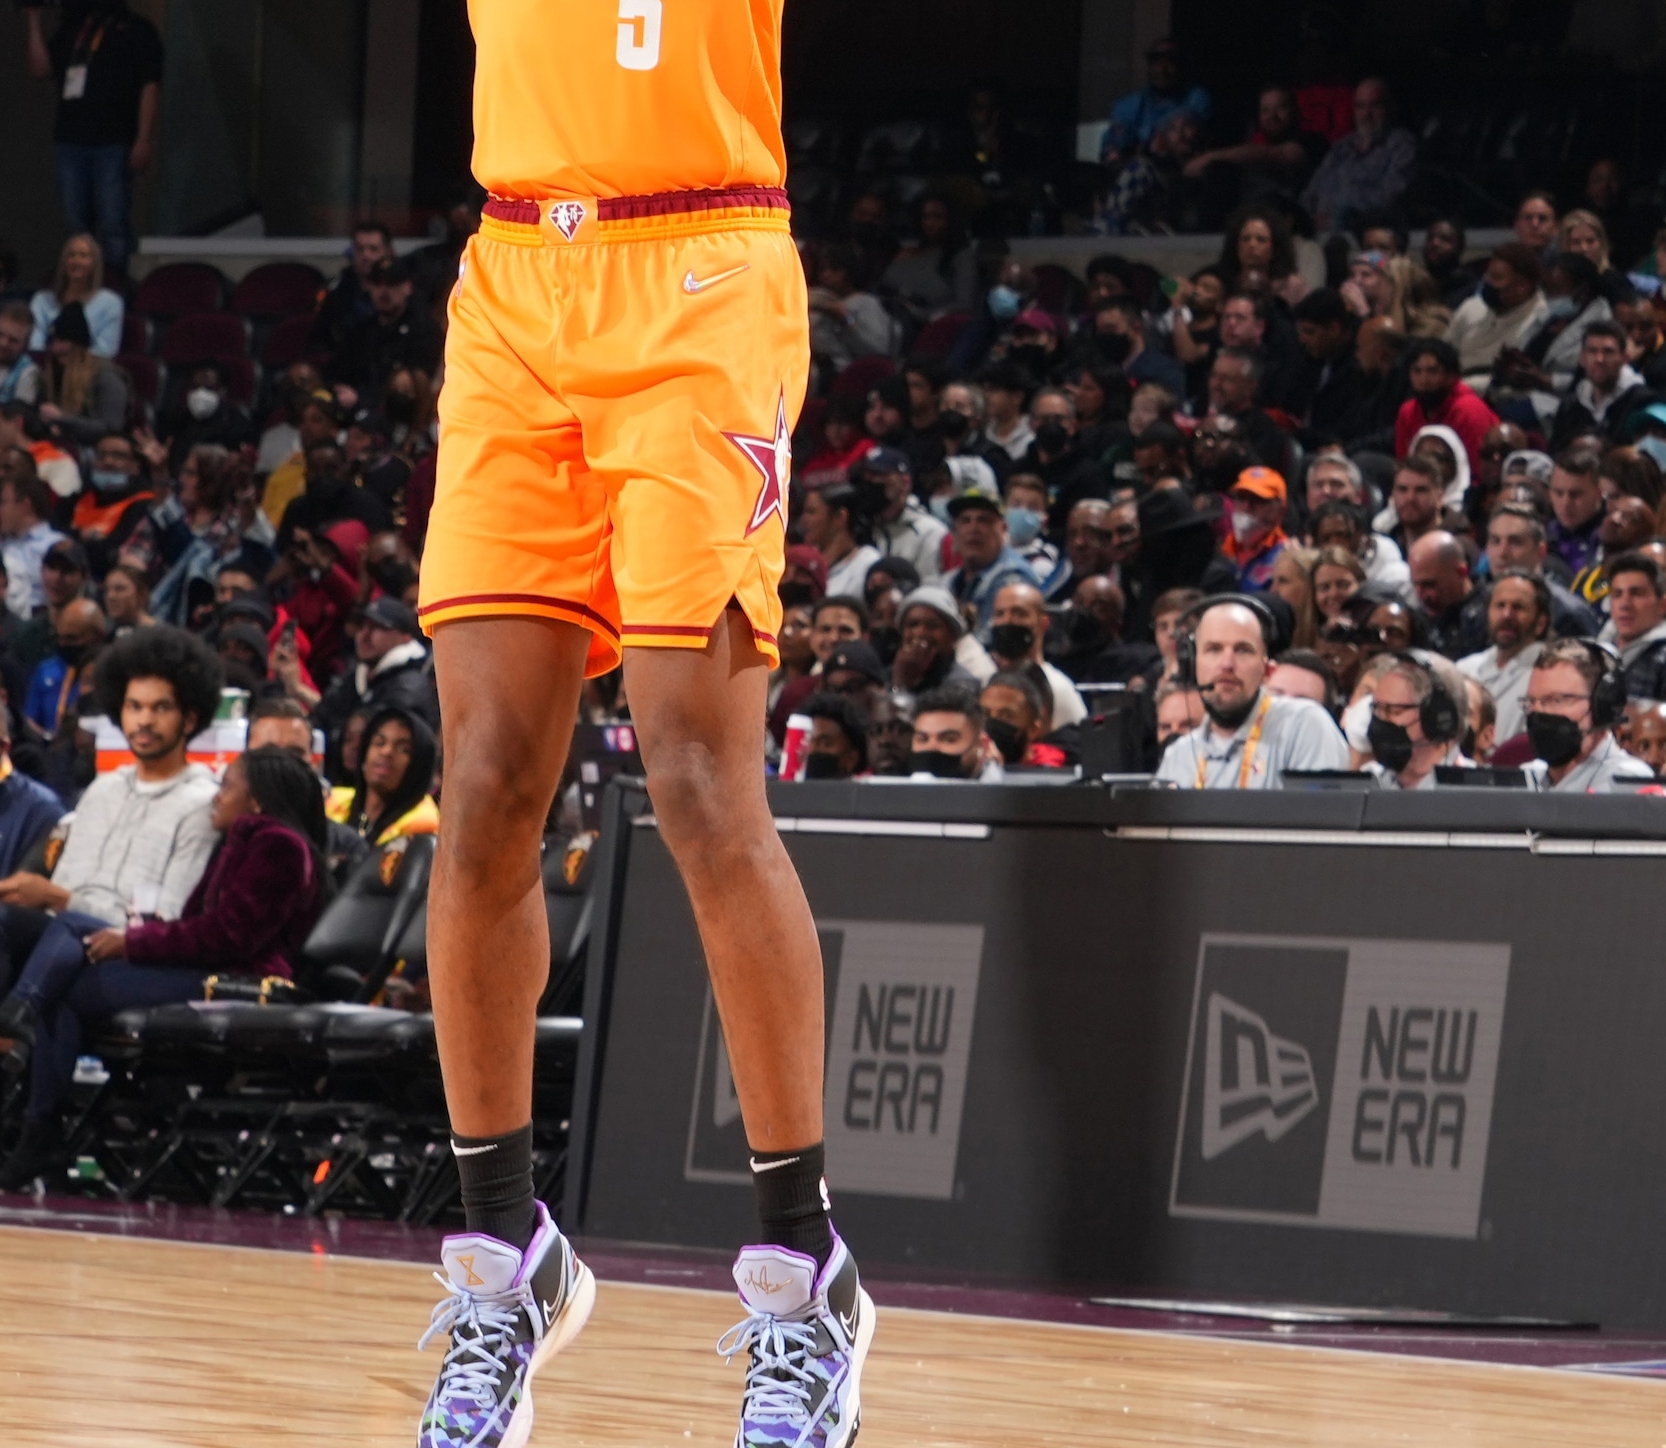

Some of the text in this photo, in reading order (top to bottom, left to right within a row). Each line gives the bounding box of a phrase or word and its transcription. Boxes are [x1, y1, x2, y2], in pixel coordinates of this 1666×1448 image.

[854, 983, 955, 1054] NEW
[1362, 1005, 1479, 1084] NEW
[844, 1059, 944, 1135] ERA
[1351, 1087, 1467, 1170] ERA
